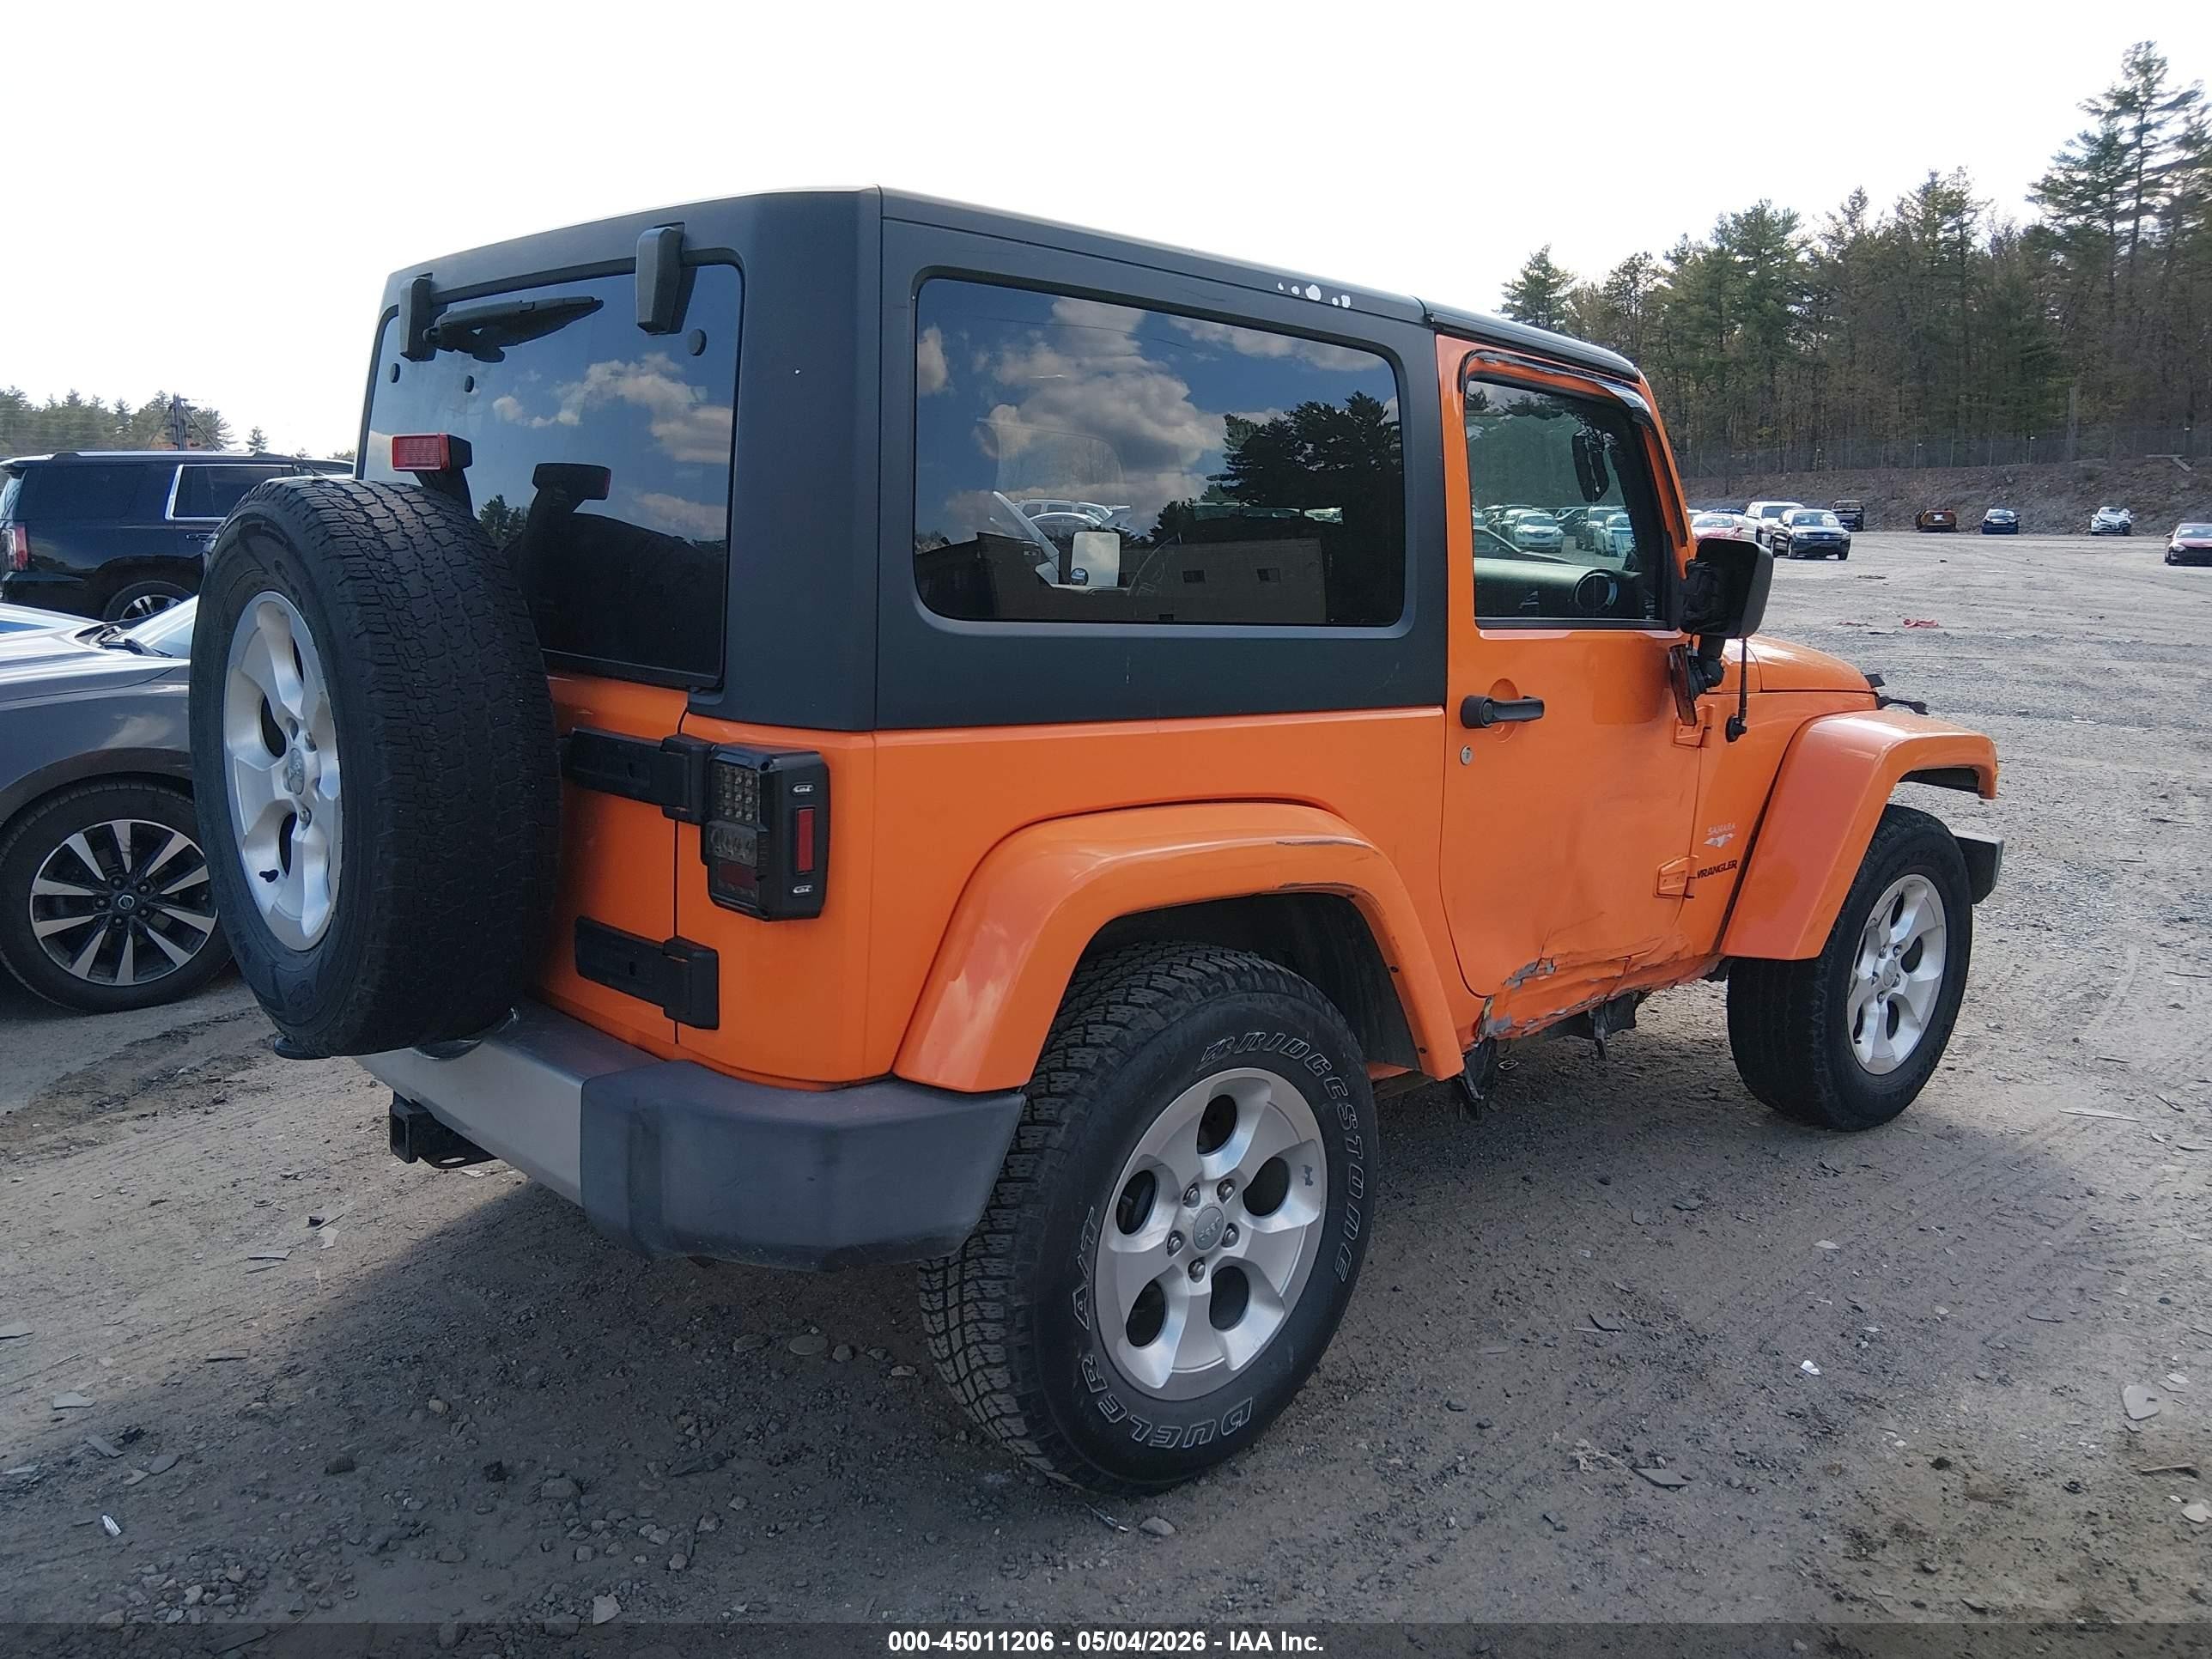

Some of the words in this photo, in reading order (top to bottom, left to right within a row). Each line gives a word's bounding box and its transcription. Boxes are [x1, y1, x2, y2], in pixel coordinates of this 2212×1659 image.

[1197, 1030, 1364, 1283] BRIDGESTONE
[1073, 1206, 1097, 1330] A/T
[1081, 1354, 1253, 1449] DUELER
